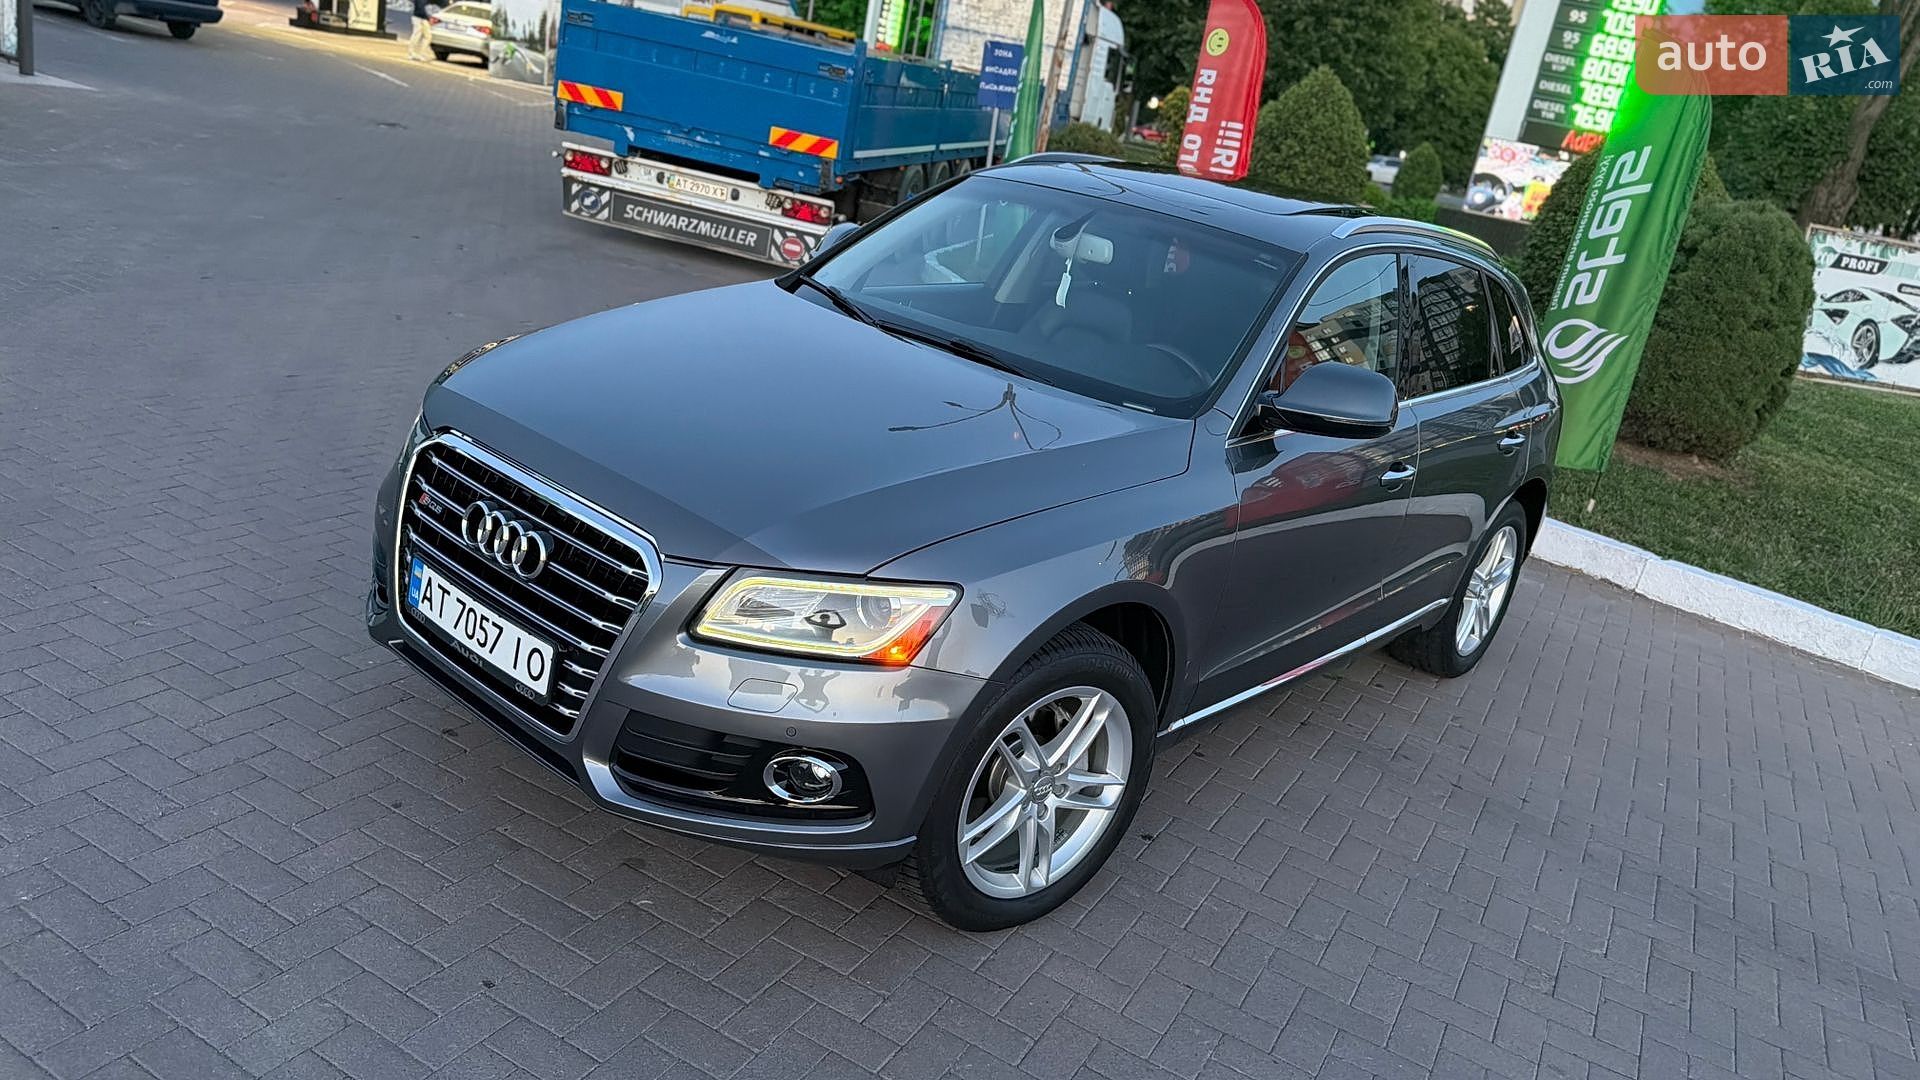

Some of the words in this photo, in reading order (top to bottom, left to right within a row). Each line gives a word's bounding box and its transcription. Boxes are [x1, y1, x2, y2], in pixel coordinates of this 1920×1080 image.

[1569, 9, 1588, 23] 95
[1602, 9, 1636, 37] 709
[994, 49, 1013, 58] ЗОНА
[1563, 30, 1581, 44] 95
[1590, 33, 1636, 63] 689
[1543, 53, 1576, 67] DIESEL
[1538, 80, 1572, 94] DIESEL
[1532, 99, 1566, 114] DIESEL
[676, 178, 688, 189] AT
[689, 182, 711, 194] 2970
[624, 204, 758, 247] SCHWARZMÜLLER
[1840, 256, 1880, 273] PROFI
[411, 590, 419, 599] UA
[421, 576, 450, 619] AT
[453, 597, 504, 655] 7057
[513, 637, 546, 682] IO
